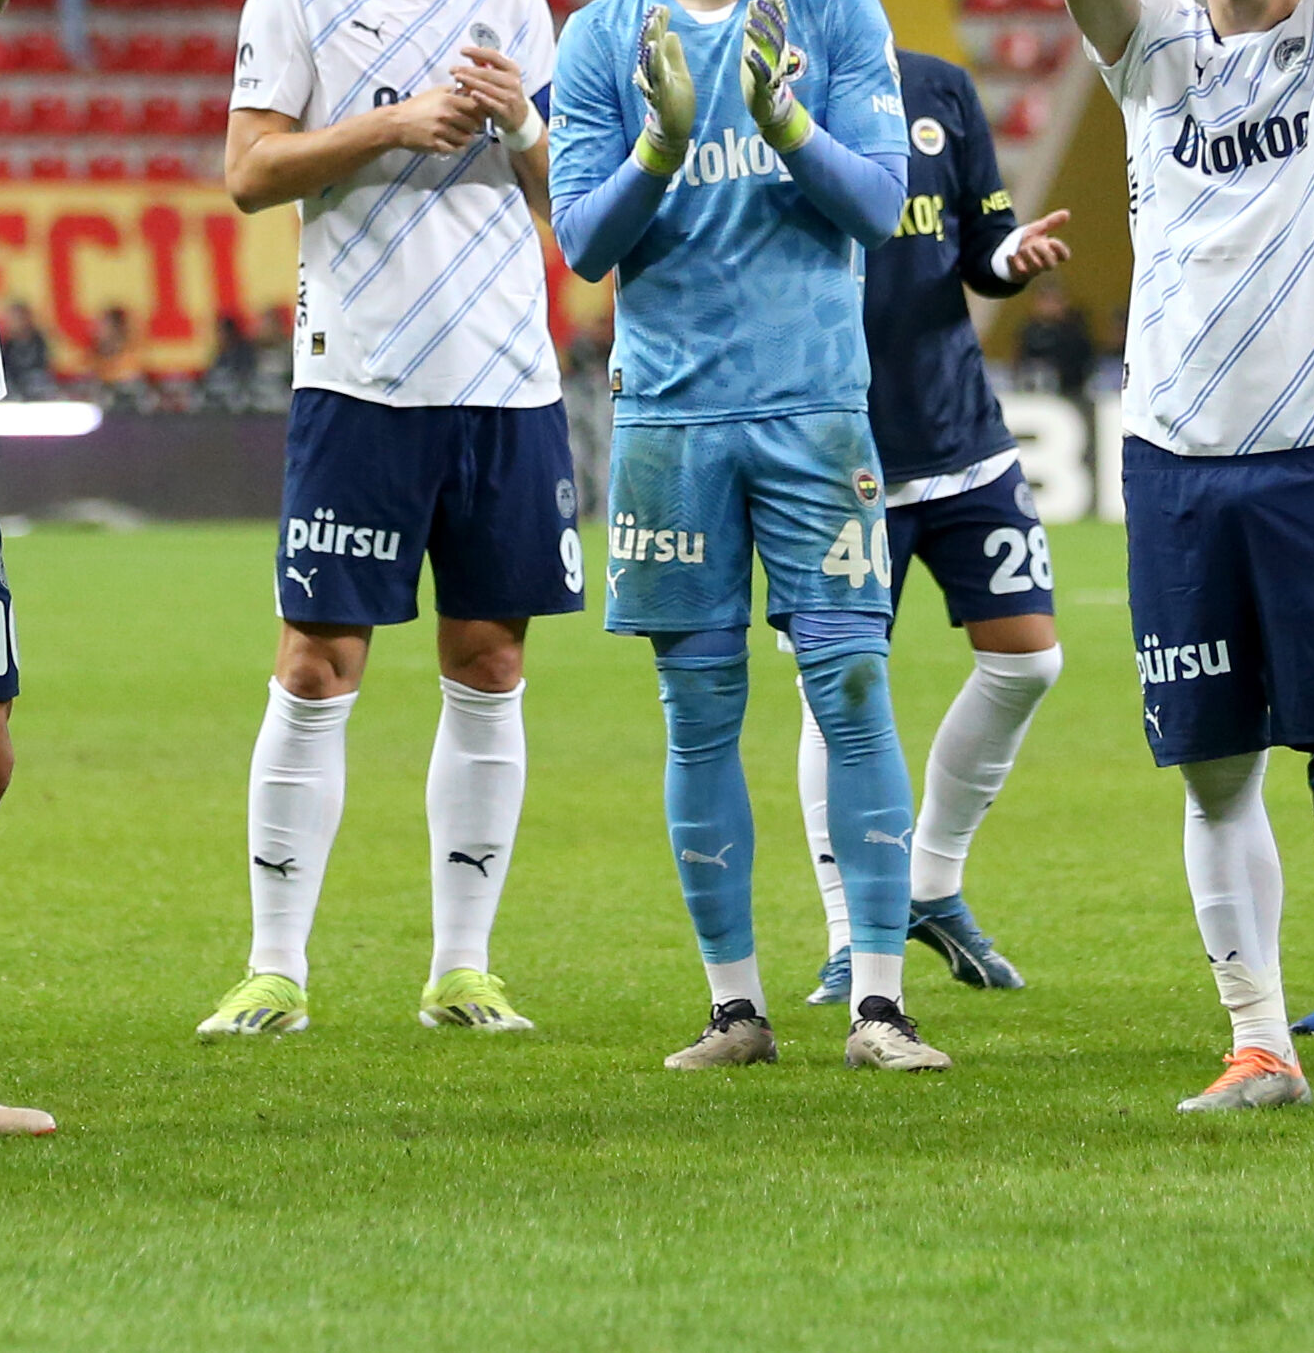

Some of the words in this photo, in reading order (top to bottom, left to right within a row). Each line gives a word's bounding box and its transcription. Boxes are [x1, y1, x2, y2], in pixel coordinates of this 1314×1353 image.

[286, 507, 401, 561] pürsu
[559, 527, 584, 594] 9
[608, 512, 705, 565] ürsu
[983, 526, 1054, 596] 28
